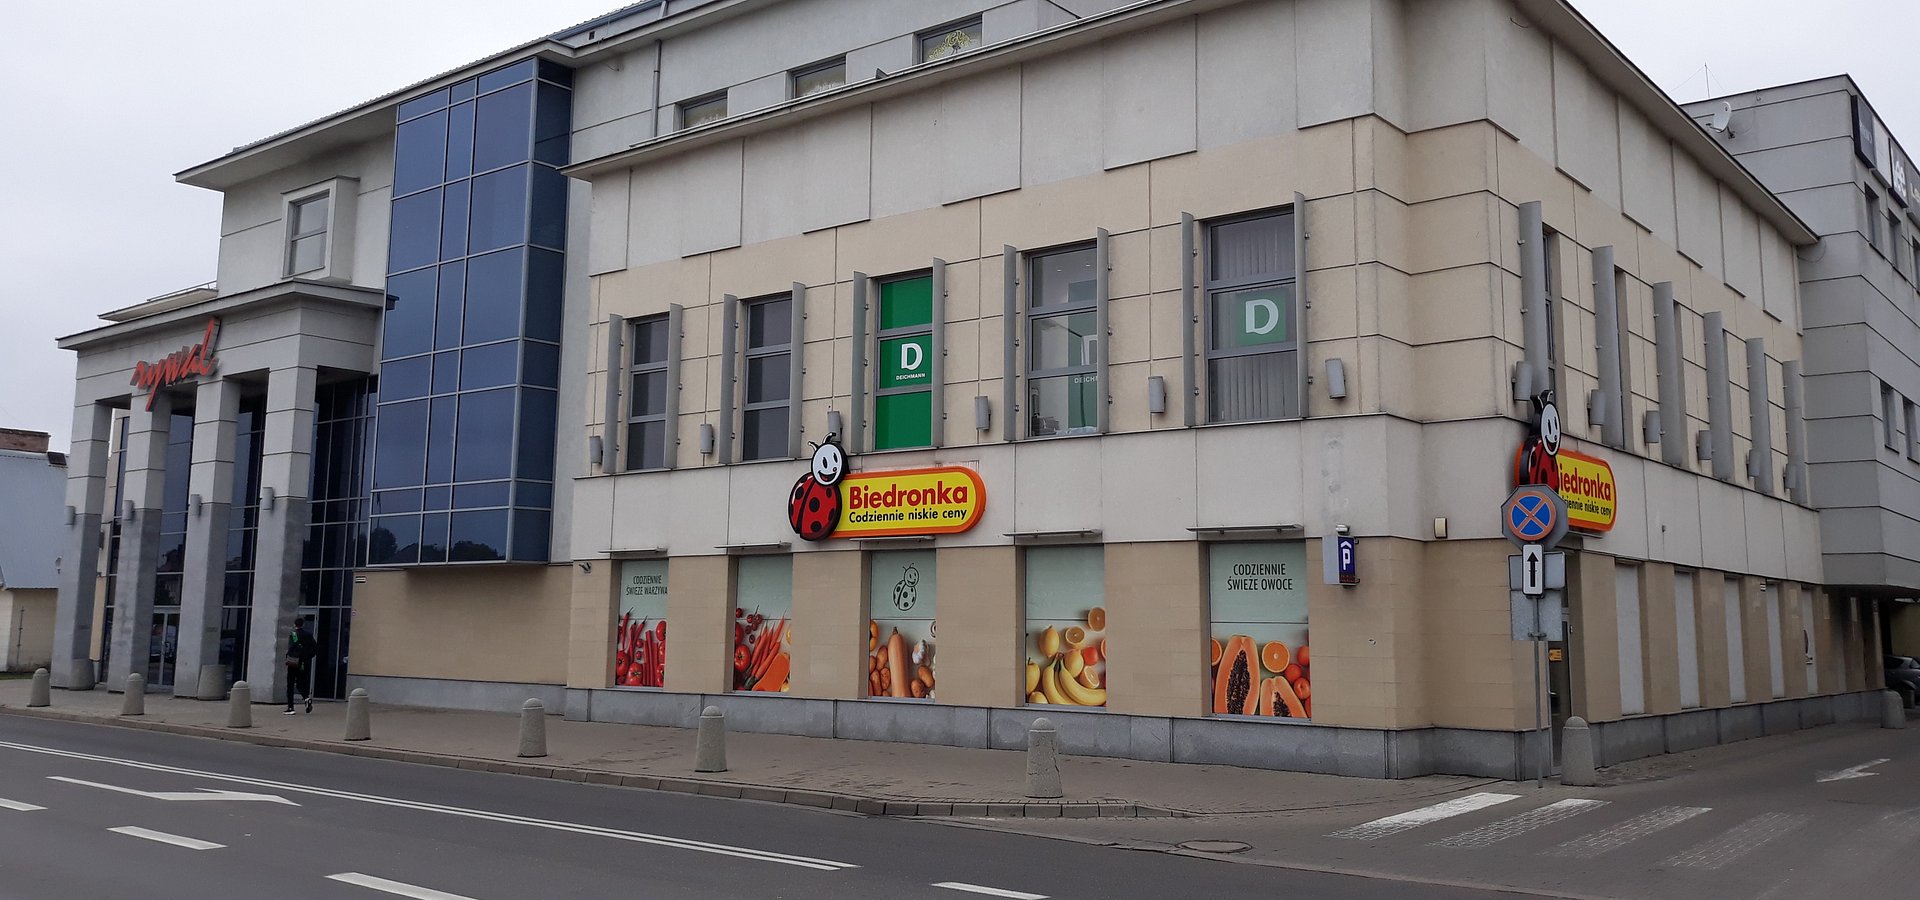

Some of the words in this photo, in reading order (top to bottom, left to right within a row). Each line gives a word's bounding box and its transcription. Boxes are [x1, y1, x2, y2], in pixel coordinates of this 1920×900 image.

[1245, 299, 1279, 335] D
[901, 343, 923, 370] D
[895, 372, 926, 381] DEICHMANN
[1560, 463, 1611, 501] iedronka
[849, 481, 968, 510] Biedronka
[849, 509, 904, 523] Codziennie
[908, 507, 938, 520] niskie
[942, 509, 967, 520] ceny
[1233, 563, 1286, 576] CODZIENNIE
[1227, 575, 1259, 591] ŚWIEŻE
[1261, 578, 1293, 591] OWOCE
